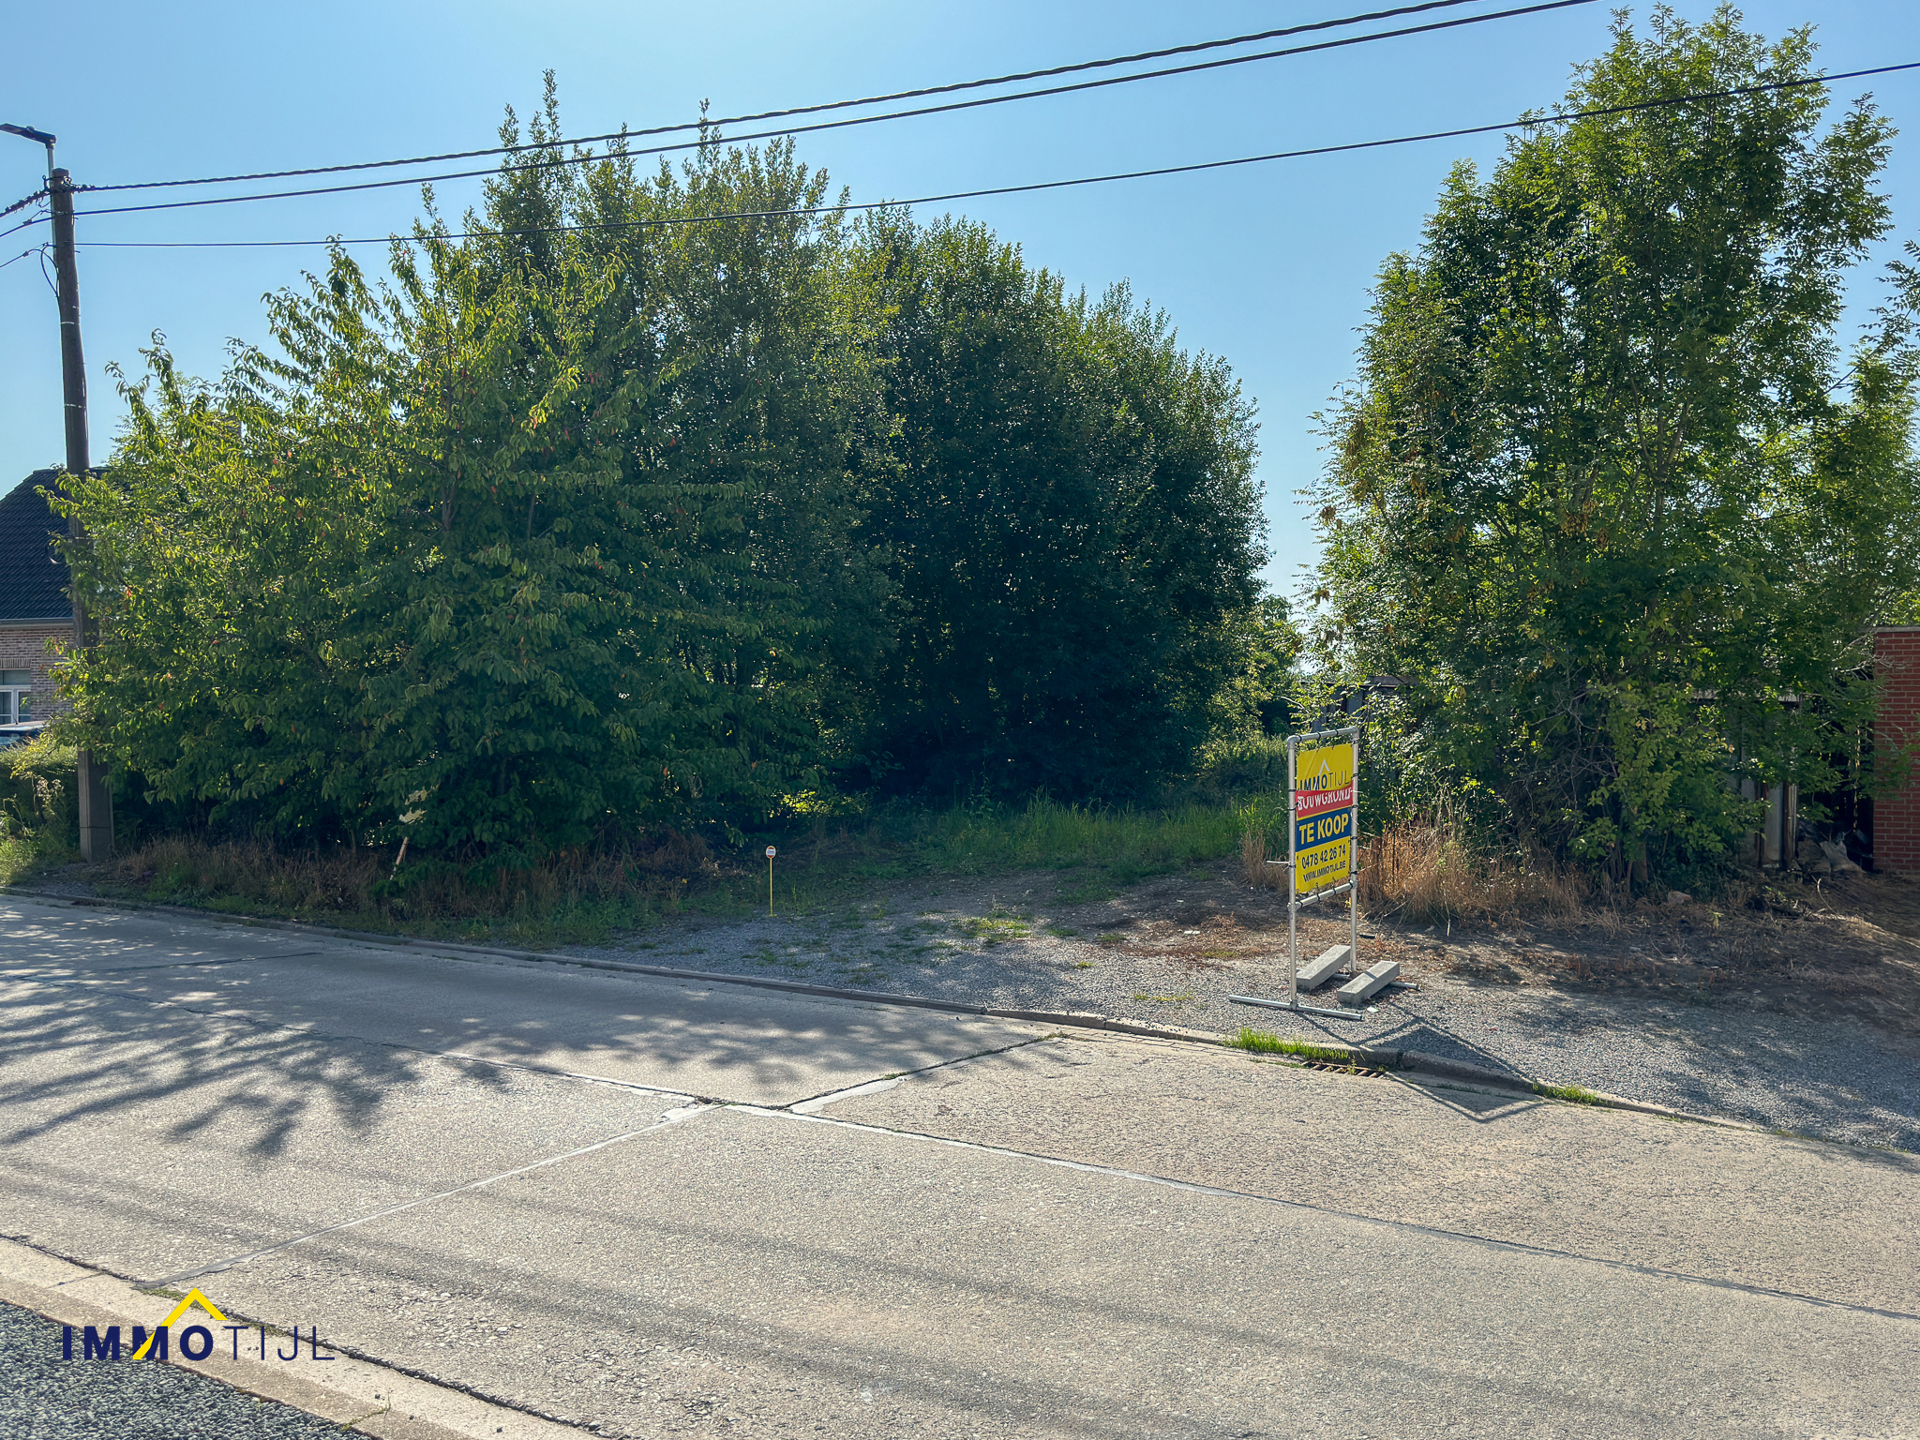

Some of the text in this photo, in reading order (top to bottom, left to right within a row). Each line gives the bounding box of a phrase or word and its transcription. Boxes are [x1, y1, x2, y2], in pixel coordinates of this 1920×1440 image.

[1299, 813, 1349, 845] TE KOOP
[1301, 844, 1346, 870] 0478 42 26 74
